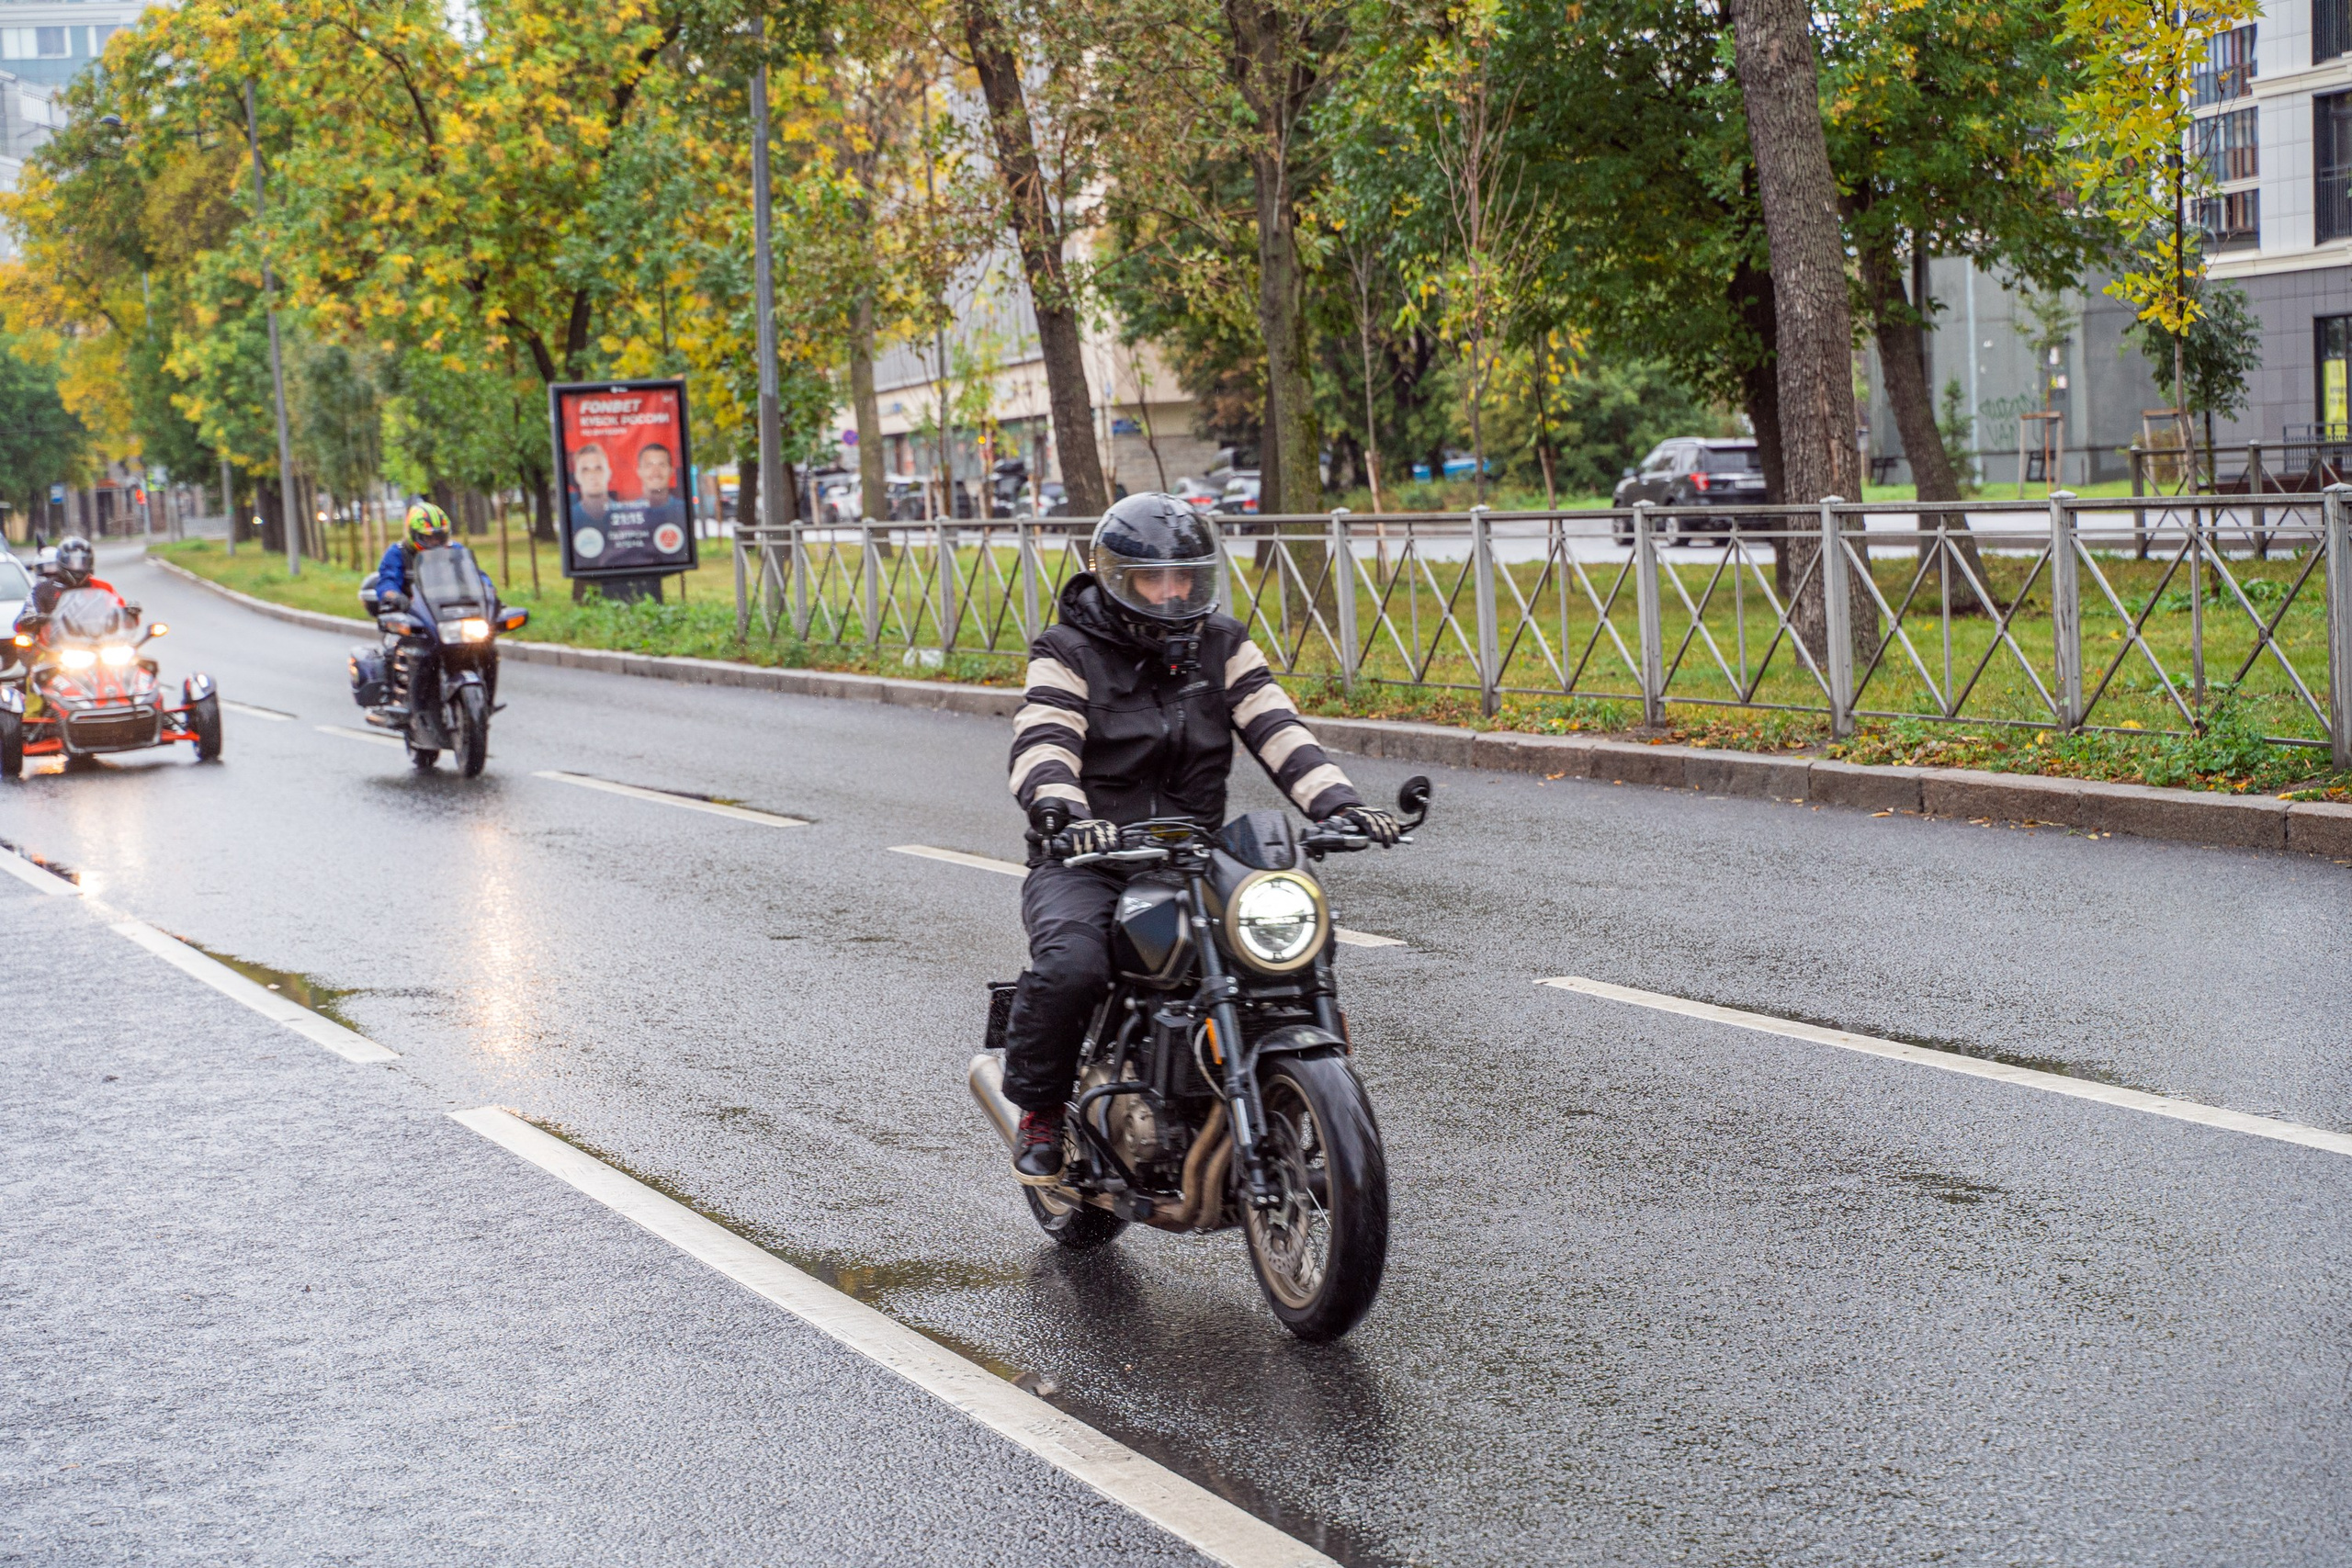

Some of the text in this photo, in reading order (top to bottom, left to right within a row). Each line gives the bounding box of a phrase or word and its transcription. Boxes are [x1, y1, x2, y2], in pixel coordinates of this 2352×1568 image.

[580, 399, 642, 414] FONBET
[580, 412, 670, 427] КУБОК РОССИИ
[610, 512, 645, 526] 21:15
